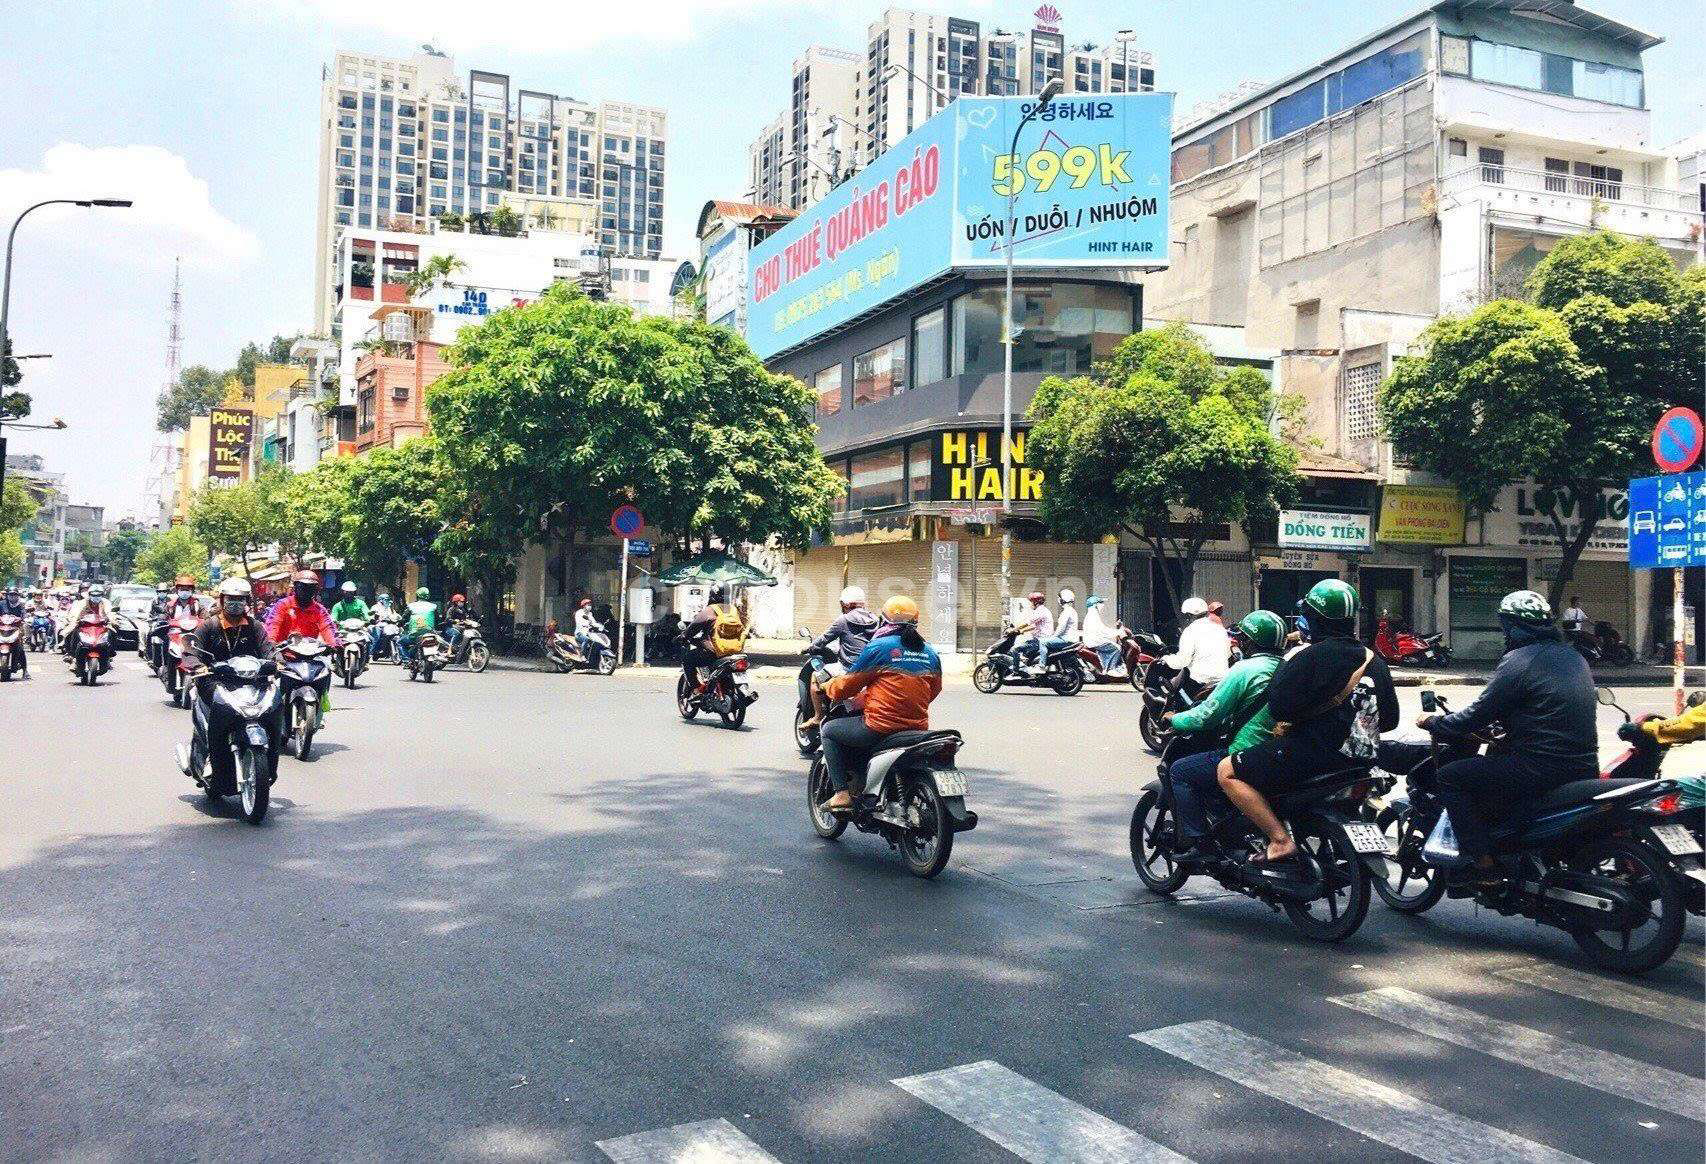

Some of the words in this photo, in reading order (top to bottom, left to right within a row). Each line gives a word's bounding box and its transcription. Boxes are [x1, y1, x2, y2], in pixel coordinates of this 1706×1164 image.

[1021, 101, 1114, 121] 안녕하세요
[992, 143, 1134, 197] 599k
[755, 254, 780, 302] CHO
[827, 187, 889, 261] QUẢNG
[895, 144, 939, 215] CÁO
[966, 214, 1004, 241] UỐN
[1025, 204, 1069, 232] DUỖI
[1076, 208, 1083, 227] /
[1090, 195, 1157, 223] NHUỘM
[1088, 241, 1117, 252] HINT
[1122, 241, 1154, 252] HAIR
[464, 290, 487, 303] 140
[212, 411, 251, 426] Phúc
[217, 429, 245, 446] Lộc
[942, 432, 1025, 464] HIN
[951, 467, 1045, 500] HAIR
[1331, 521, 1366, 540] TIẾN
